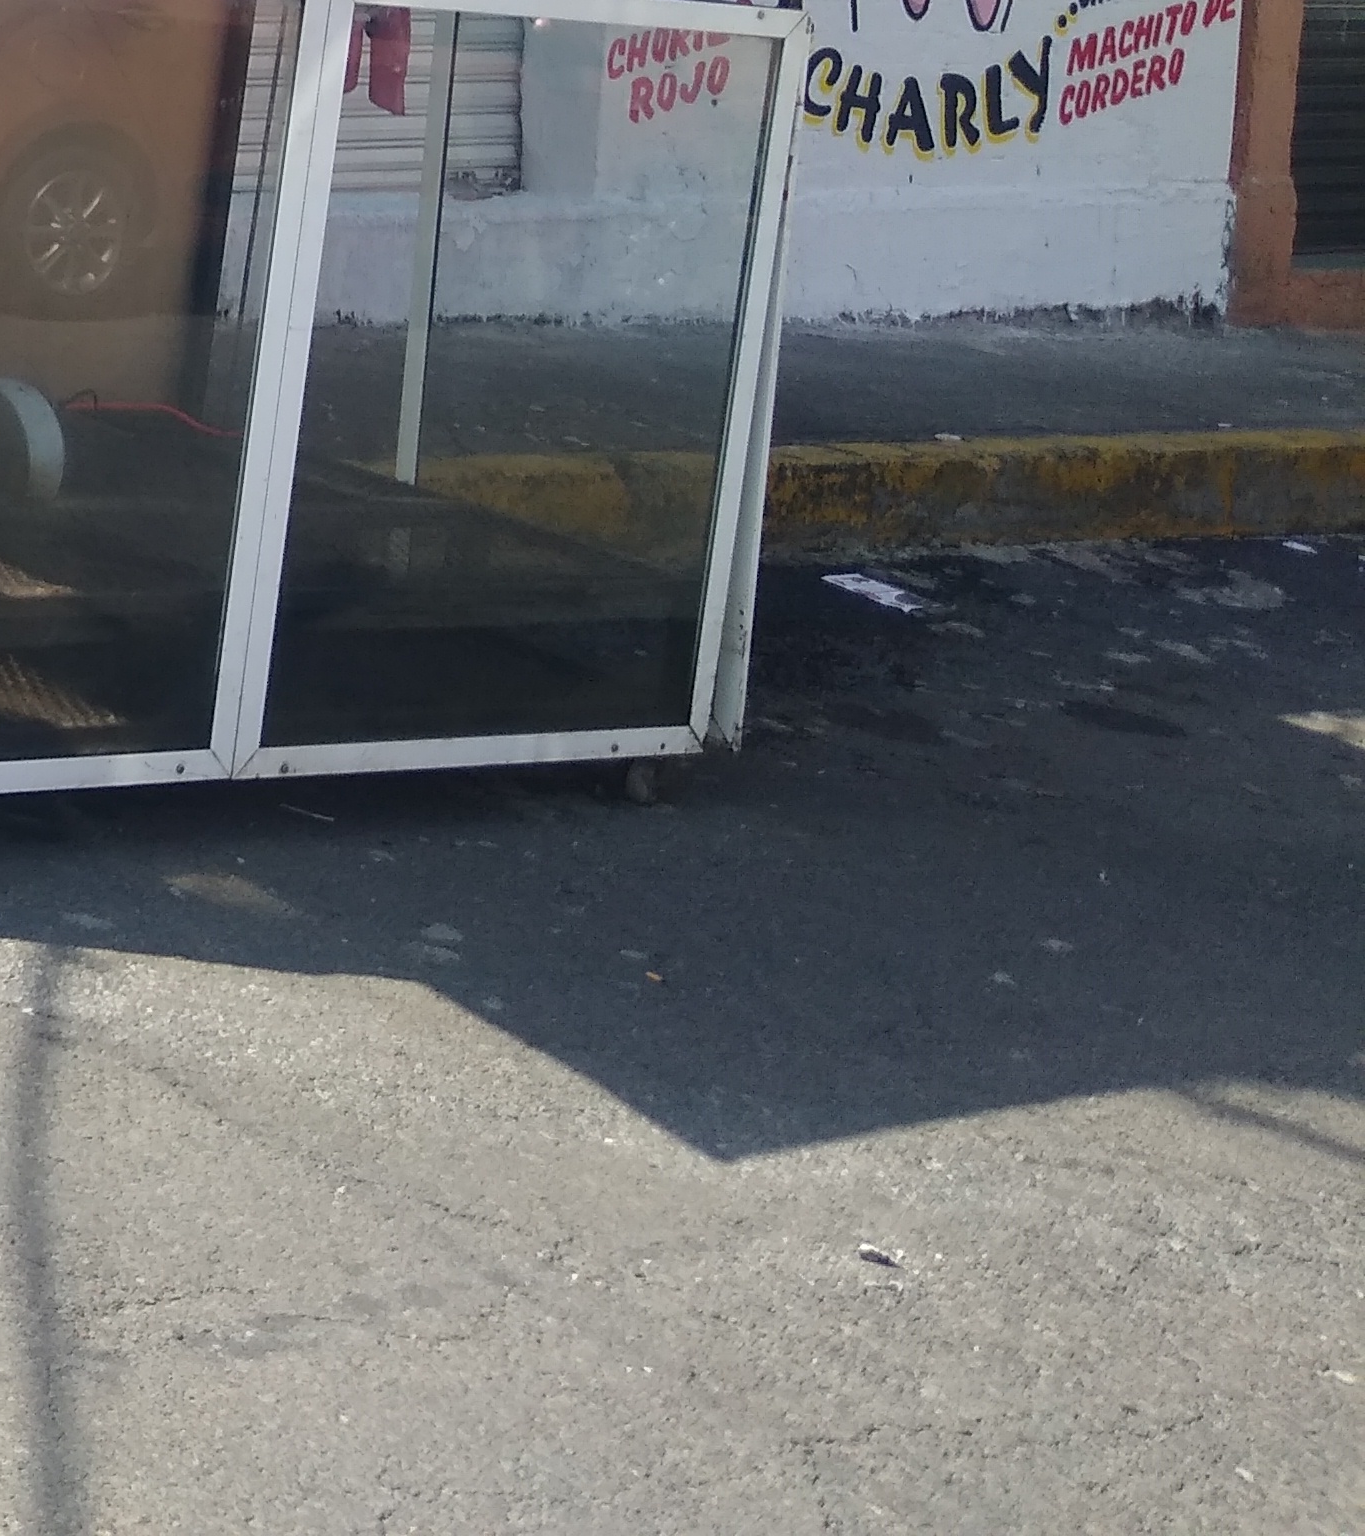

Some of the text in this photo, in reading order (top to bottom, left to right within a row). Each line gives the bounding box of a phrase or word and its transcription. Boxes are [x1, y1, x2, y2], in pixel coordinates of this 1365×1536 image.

[1065, 0, 1198, 76] MACHITO
[628, 55, 732, 124] ROJO
[1058, 47, 1186, 126] CORDERO
